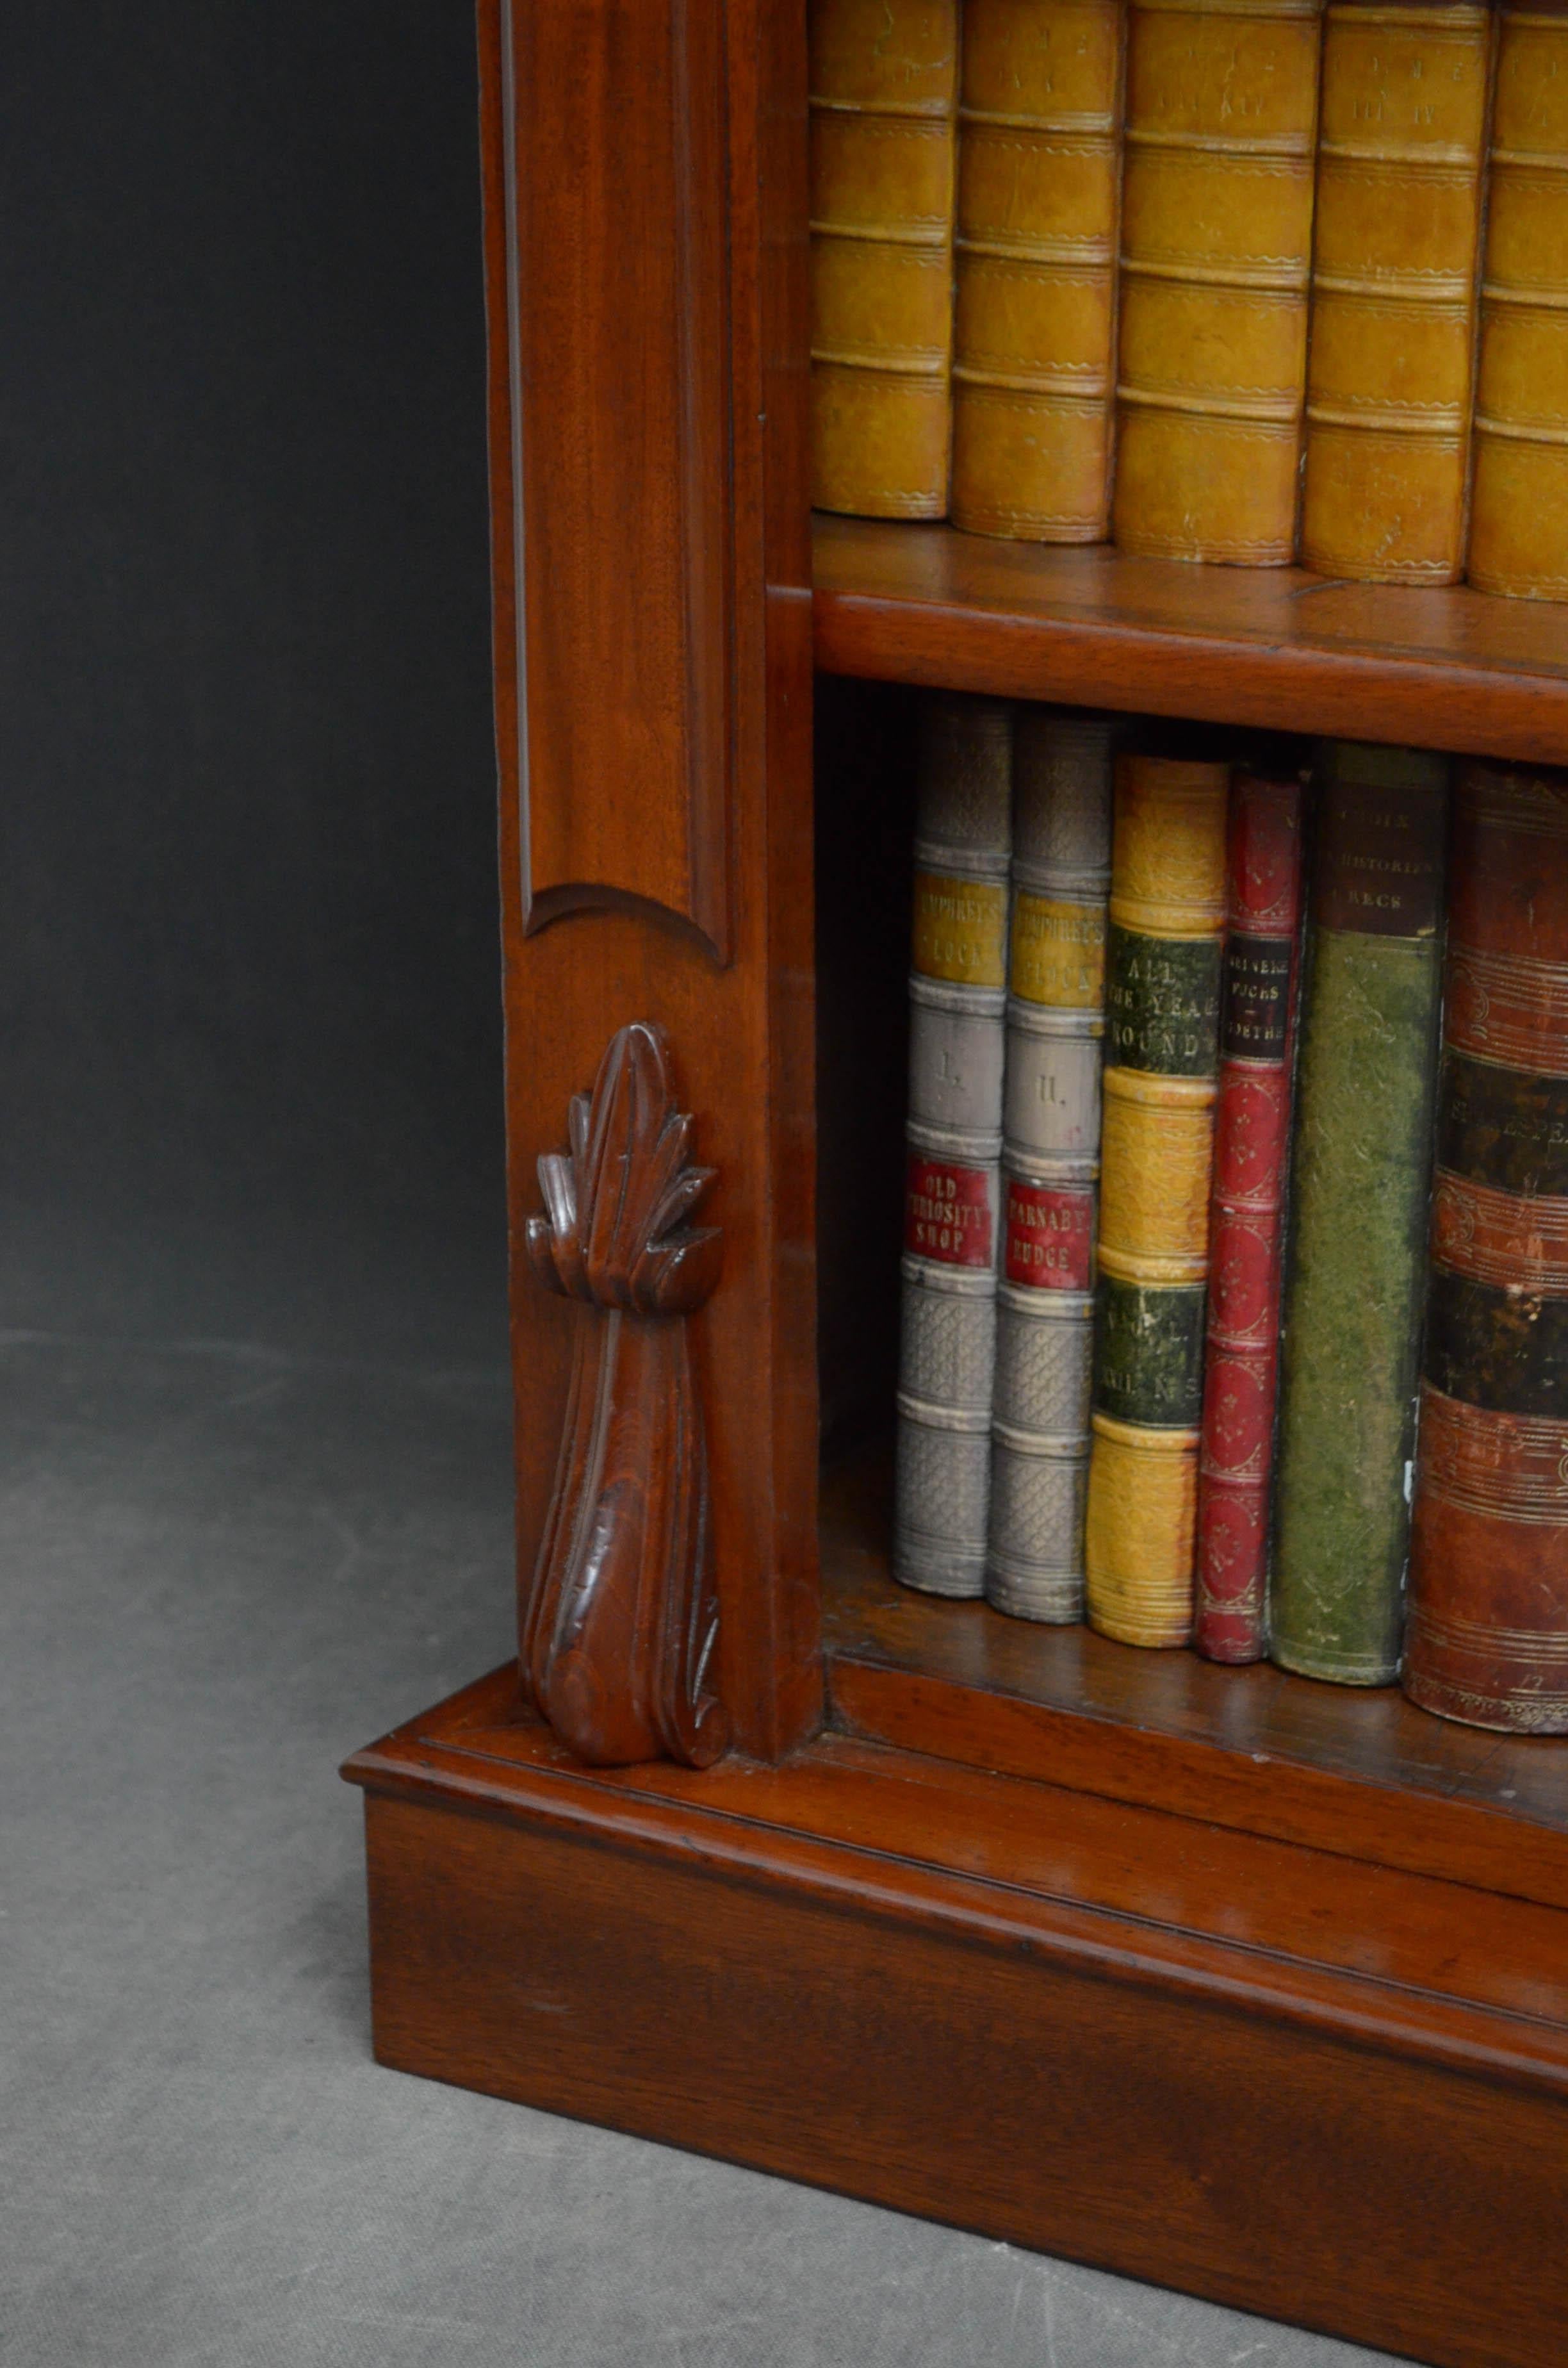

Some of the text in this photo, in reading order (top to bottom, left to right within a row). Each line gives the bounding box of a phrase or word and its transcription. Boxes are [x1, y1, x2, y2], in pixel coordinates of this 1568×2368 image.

[920, 935, 982, 966] LOCK
[1127, 958, 1177, 985] ALL
[1228, 1021, 1284, 1040] OETHE
[926, 1174, 958, 1200] OLD
[915, 1222, 964, 1253] SHOP
[1013, 1238, 1070, 1270] RUDGE
